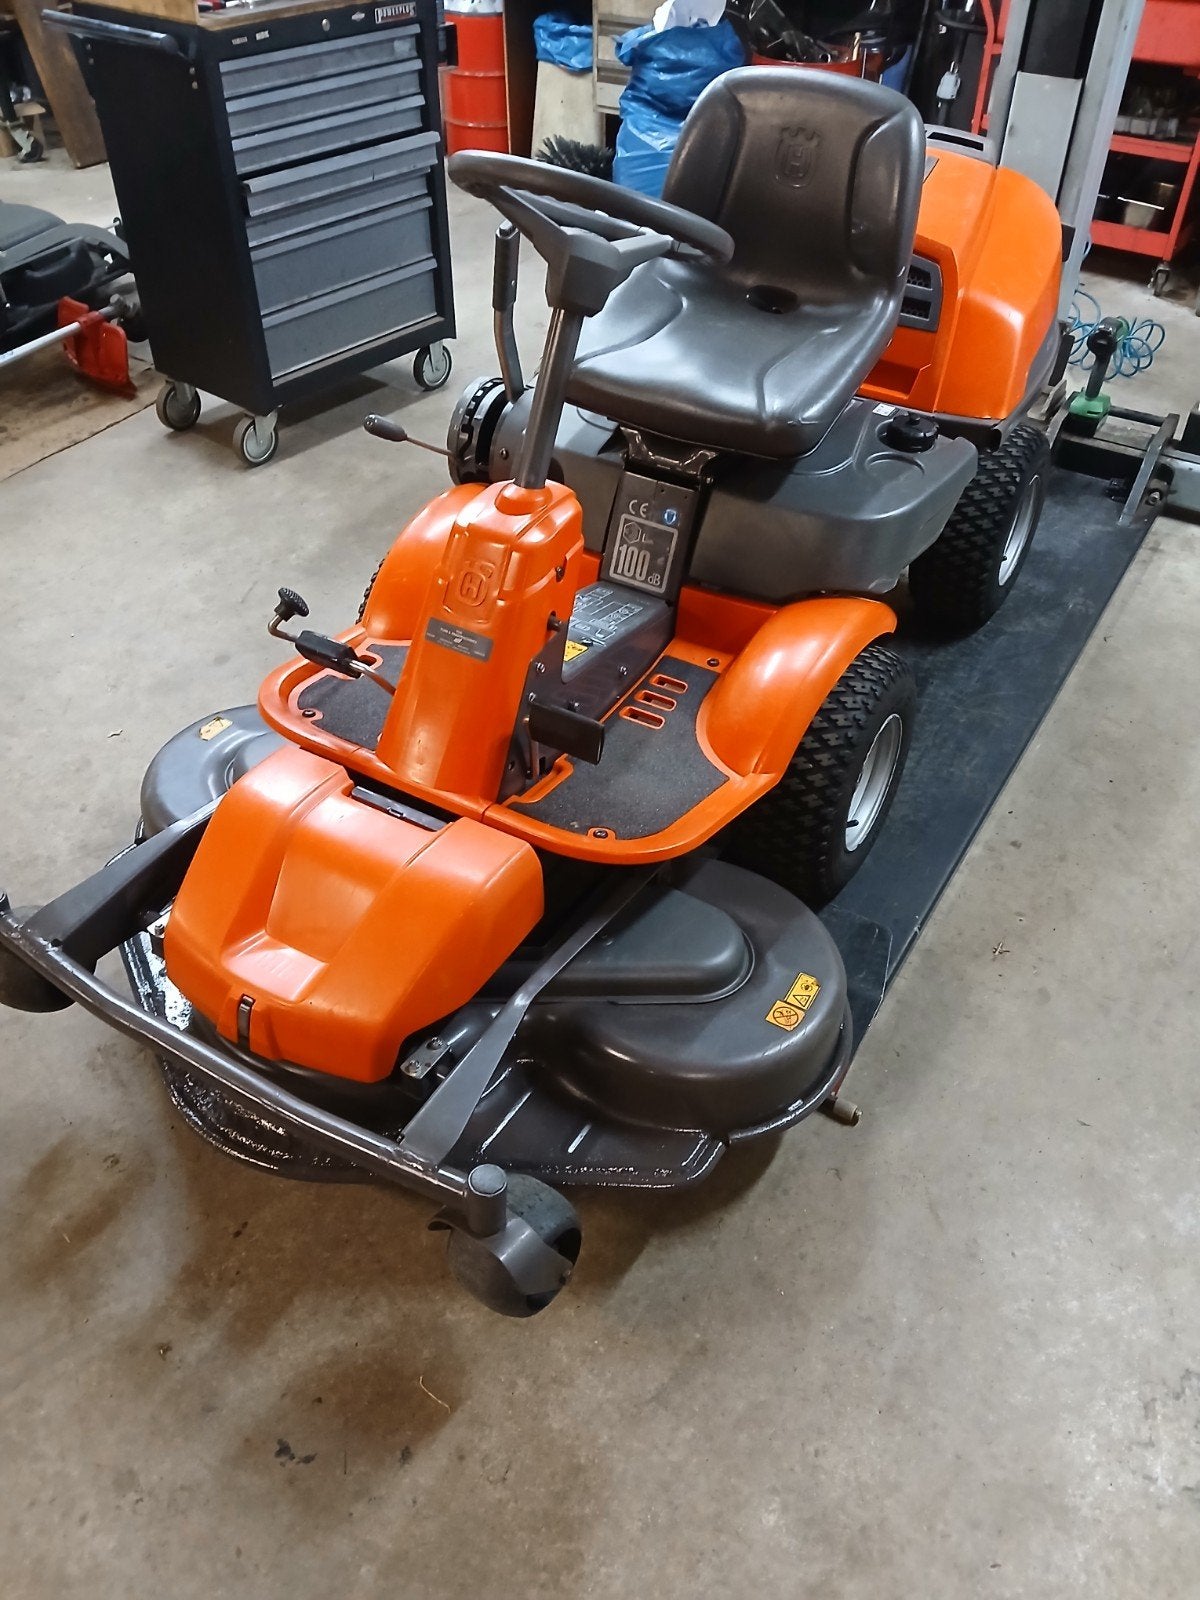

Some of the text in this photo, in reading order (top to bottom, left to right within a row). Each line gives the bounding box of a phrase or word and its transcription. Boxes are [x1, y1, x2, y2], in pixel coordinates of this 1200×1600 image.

[629, 499, 649, 518] CE
[617, 544, 661, 586] 100 dB
